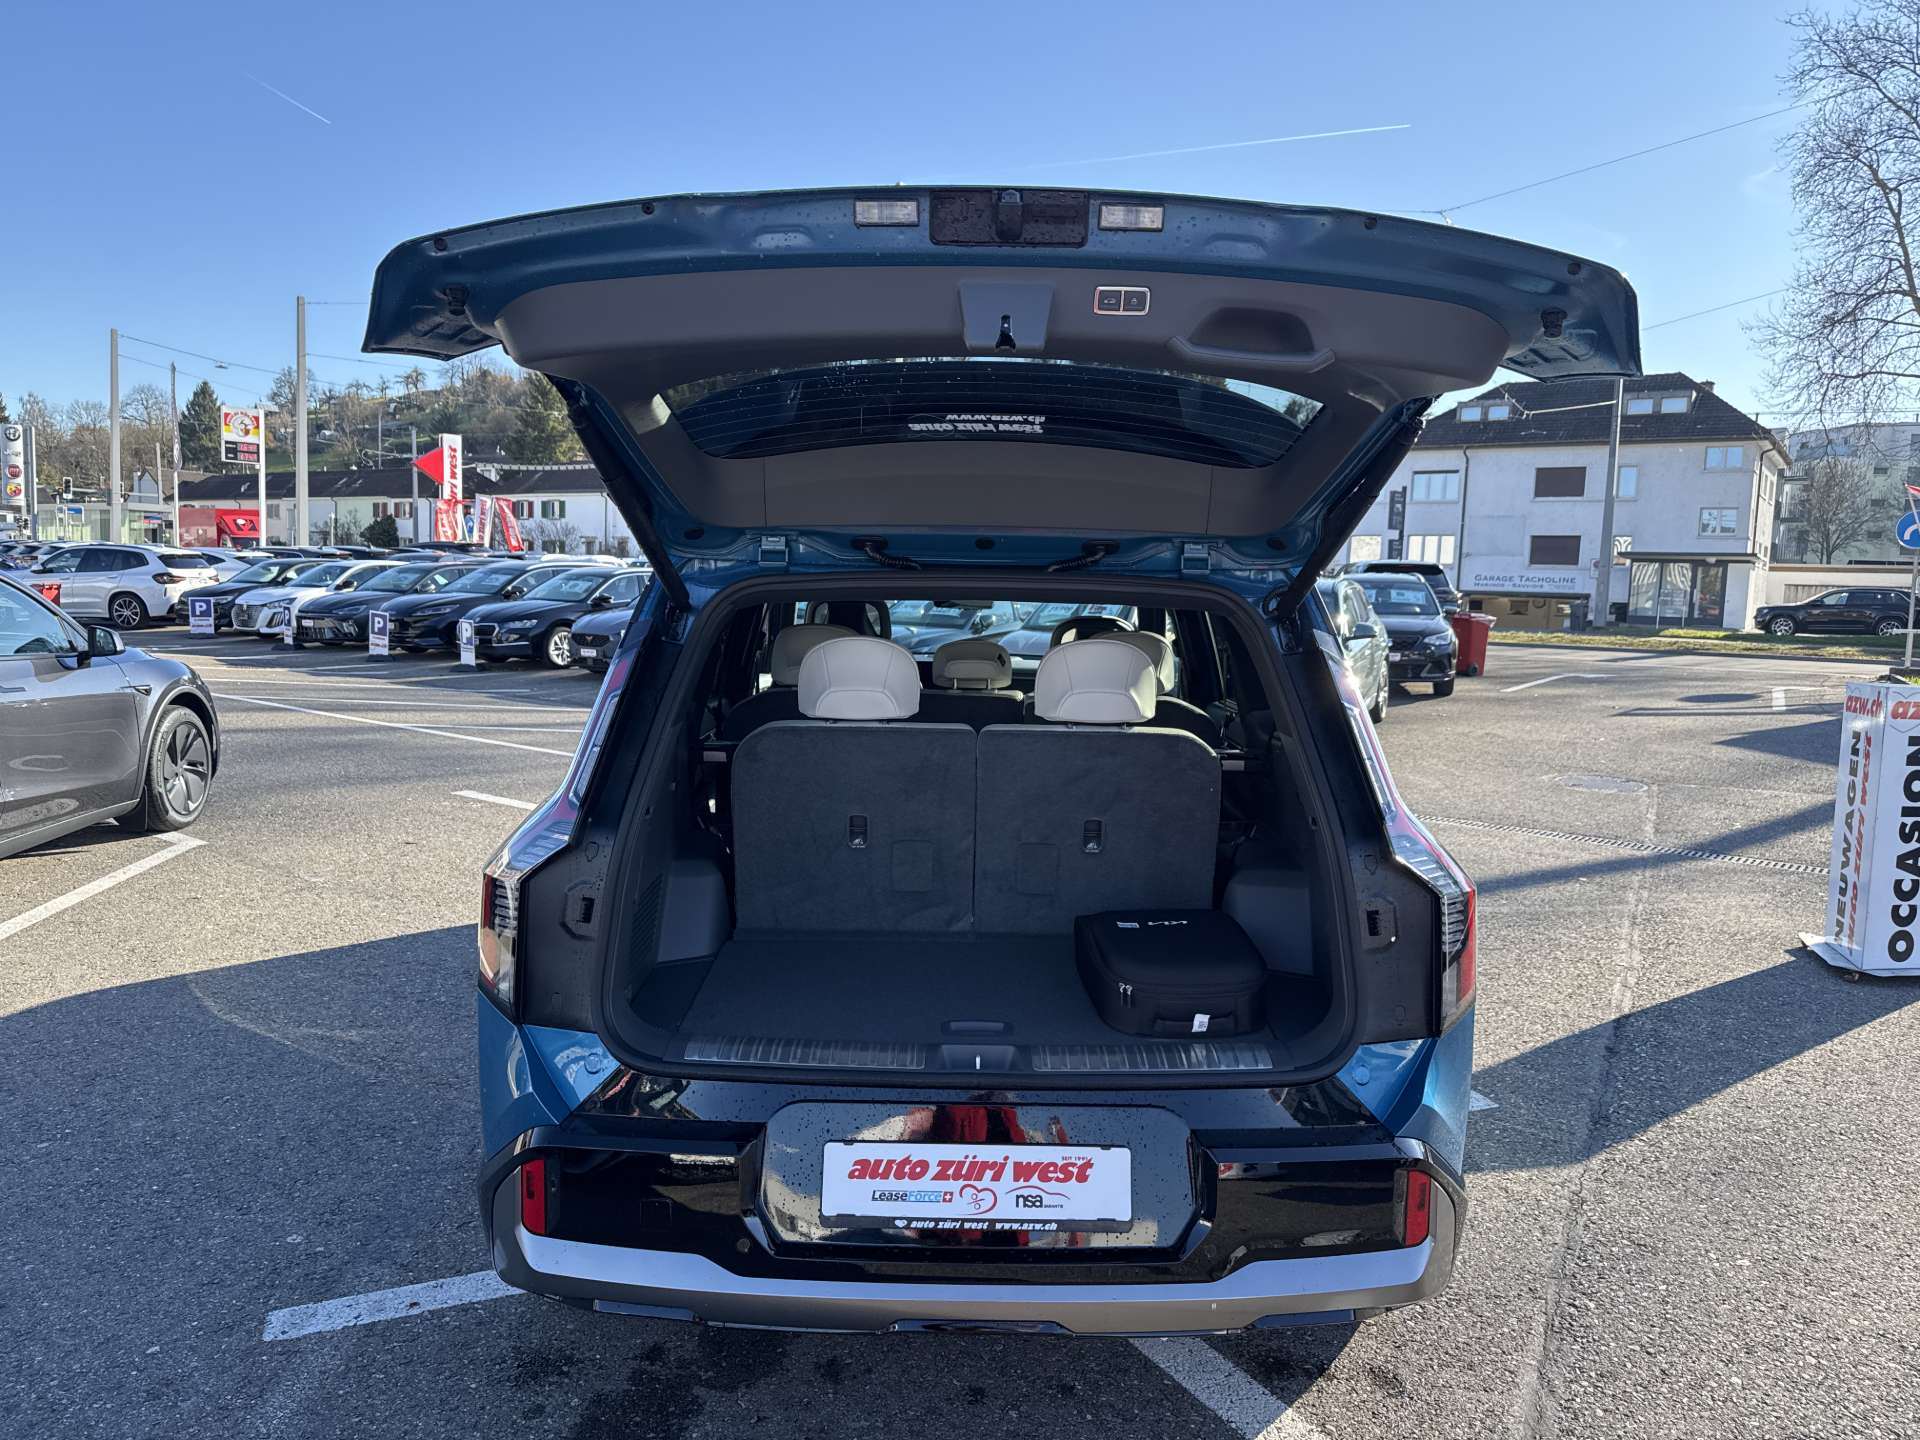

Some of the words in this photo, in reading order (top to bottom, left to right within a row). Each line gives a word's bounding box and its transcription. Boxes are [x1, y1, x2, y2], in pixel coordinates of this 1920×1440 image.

[1474, 574, 1514, 582] GARAGE
[1518, 575, 1576, 583] TACHOLINE
[1845, 691, 1882, 718] azw.ch
[1860, 730, 1872, 806] west
[1833, 730, 1861, 943] NEUWAGEN
[848, 1155, 928, 1181] auto
[931, 1155, 1010, 1182] züri
[1012, 1156, 1094, 1183] west
[872, 1190, 942, 1202] LeaseForce
[1015, 1193, 1043, 1208] nsa
[910, 1220, 934, 1229] auto
[936, 1220, 962, 1230] züri
[963, 1220, 989, 1230] west
[995, 1221, 1058, 1231] www.azw.ch
